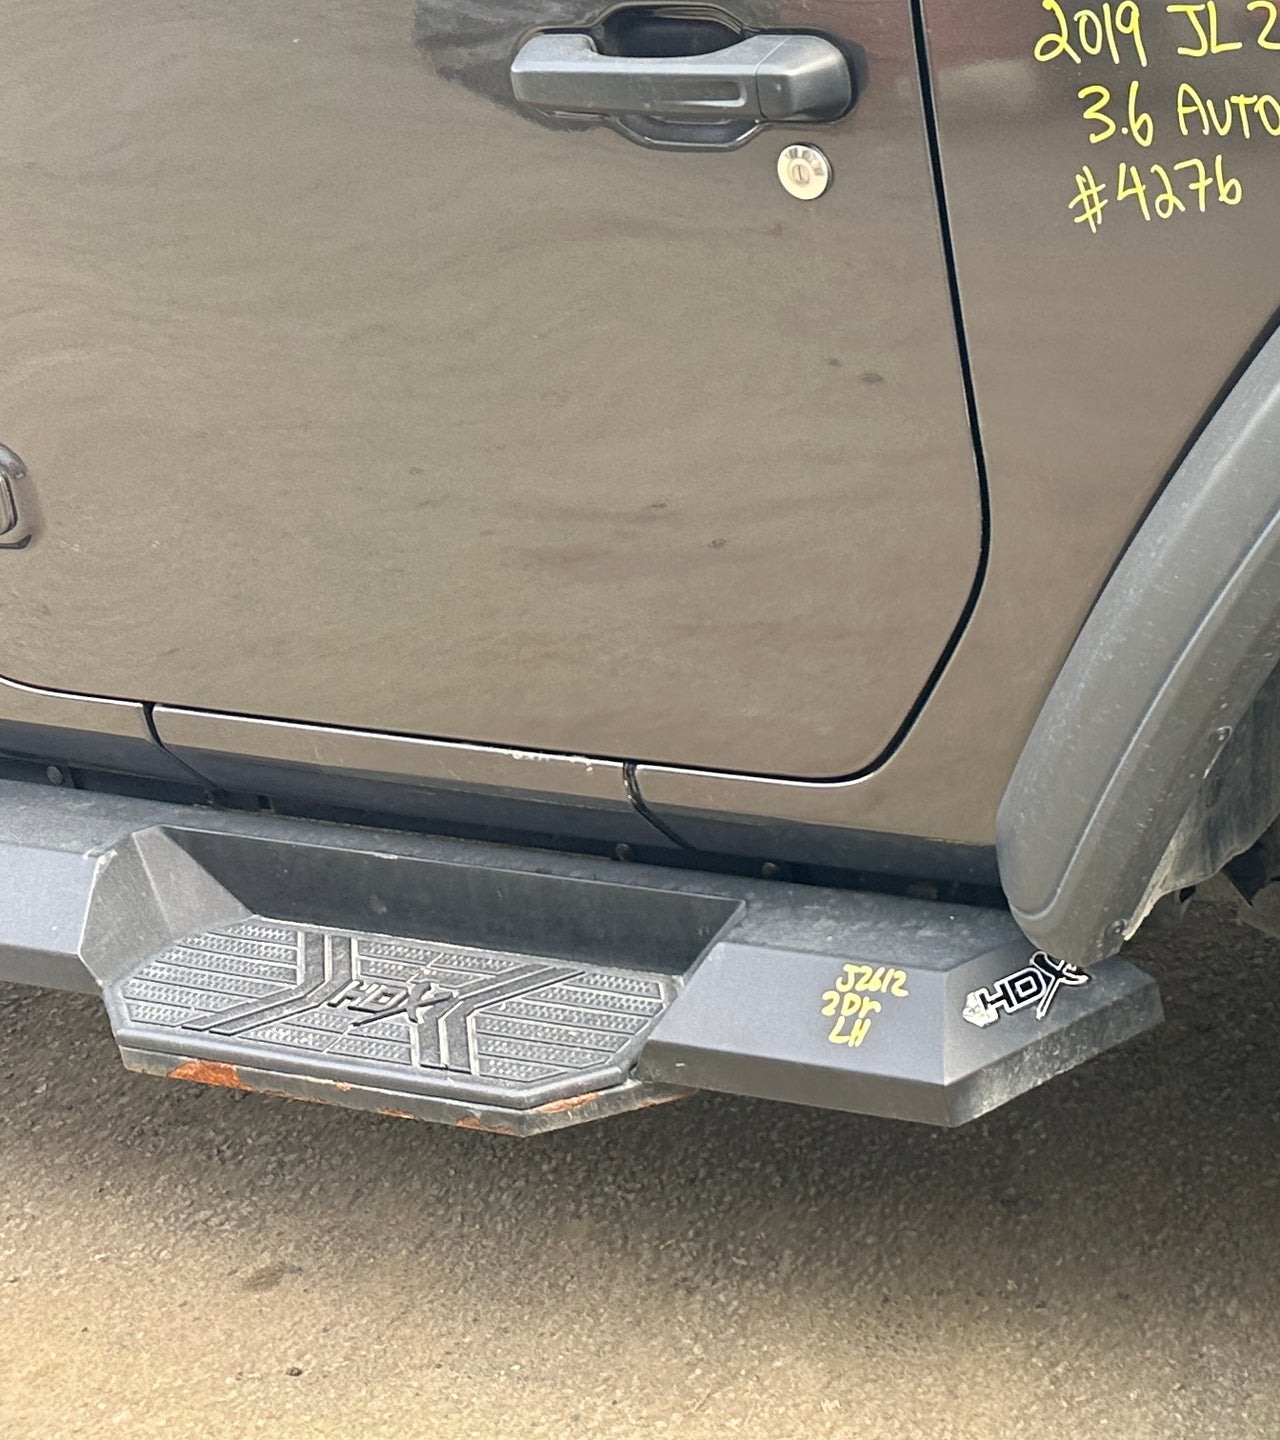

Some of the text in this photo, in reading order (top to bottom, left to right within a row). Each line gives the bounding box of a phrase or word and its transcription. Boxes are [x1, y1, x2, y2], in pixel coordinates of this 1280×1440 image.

[1166, 0, 1243, 57] JL
[1077, 80, 1154, 147] 3.6
[1068, 155, 1243, 234] #4276
[836, 963, 910, 997] J2612
[828, 1015, 872, 1048] LH
